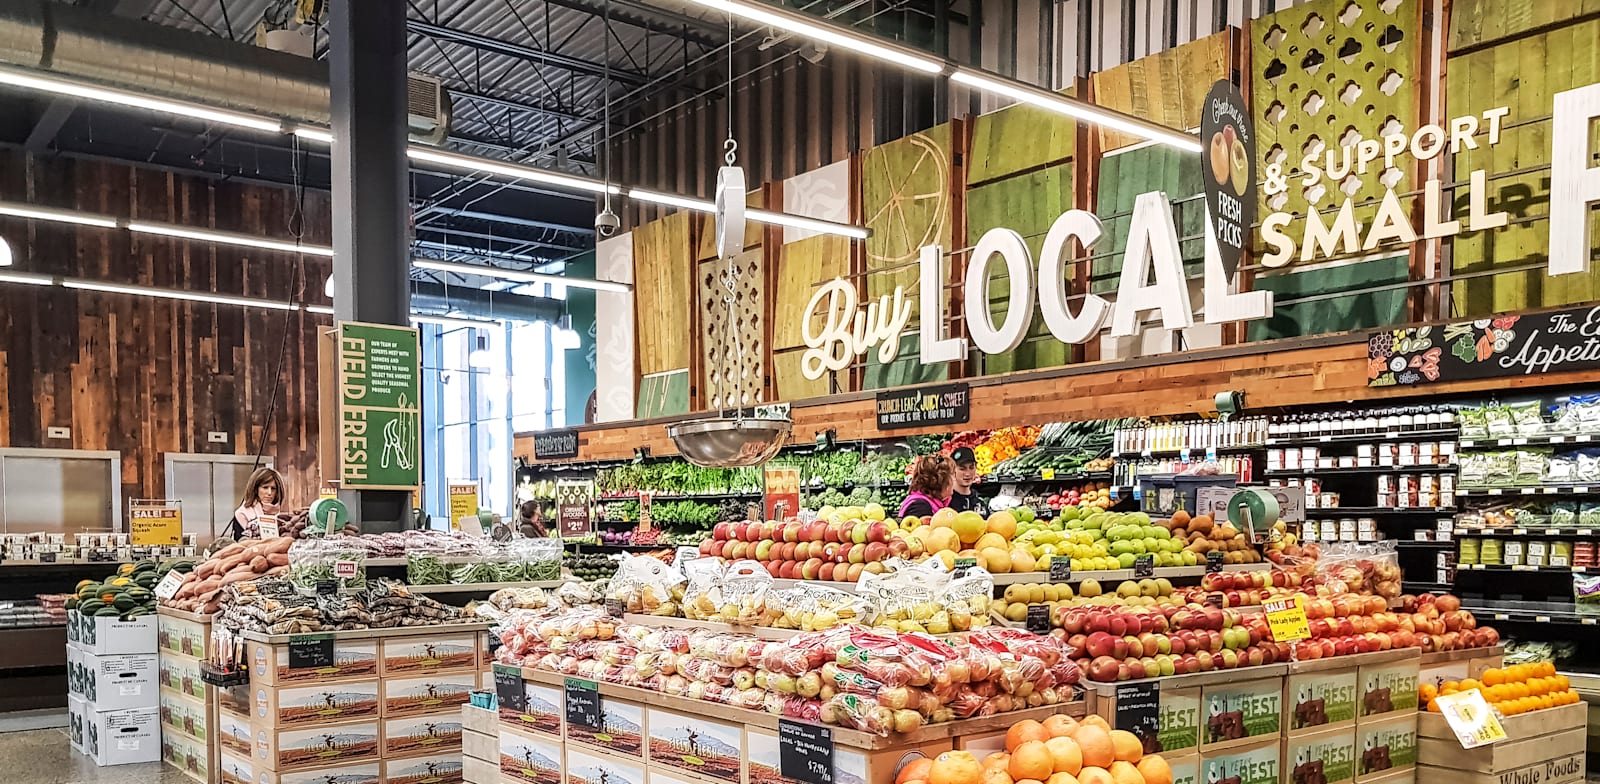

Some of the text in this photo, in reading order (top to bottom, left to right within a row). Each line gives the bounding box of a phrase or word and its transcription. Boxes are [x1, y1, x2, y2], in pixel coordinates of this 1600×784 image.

[1263, 106, 1509, 195] & SUPPORT
[1218, 190, 1242, 225] FRESH
[1260, 169, 1508, 268] SMALL
[1218, 217, 1242, 249] PICKS
[801, 188, 1274, 381] Buy LOCAL
[1547, 313, 1577, 334] The
[343, 337, 367, 400] FIELD
[921, 394, 940, 412] JUICY
[944, 391, 966, 408] SWEET
[344, 407, 368, 479] FRESH
[134, 510, 162, 518] SALE!
[338, 563, 354, 573] LOCAL
[1324, 686, 1354, 704] BEST
[1390, 676, 1418, 694] BEST
[1242, 696, 1278, 718] BEST
[1159, 708, 1196, 731] BEST
[1389, 732, 1416, 750] BEST
[1322, 744, 1352, 766] BEST
[1240, 760, 1276, 782] BEST
[1500, 758, 1581, 784] Whole Foods
